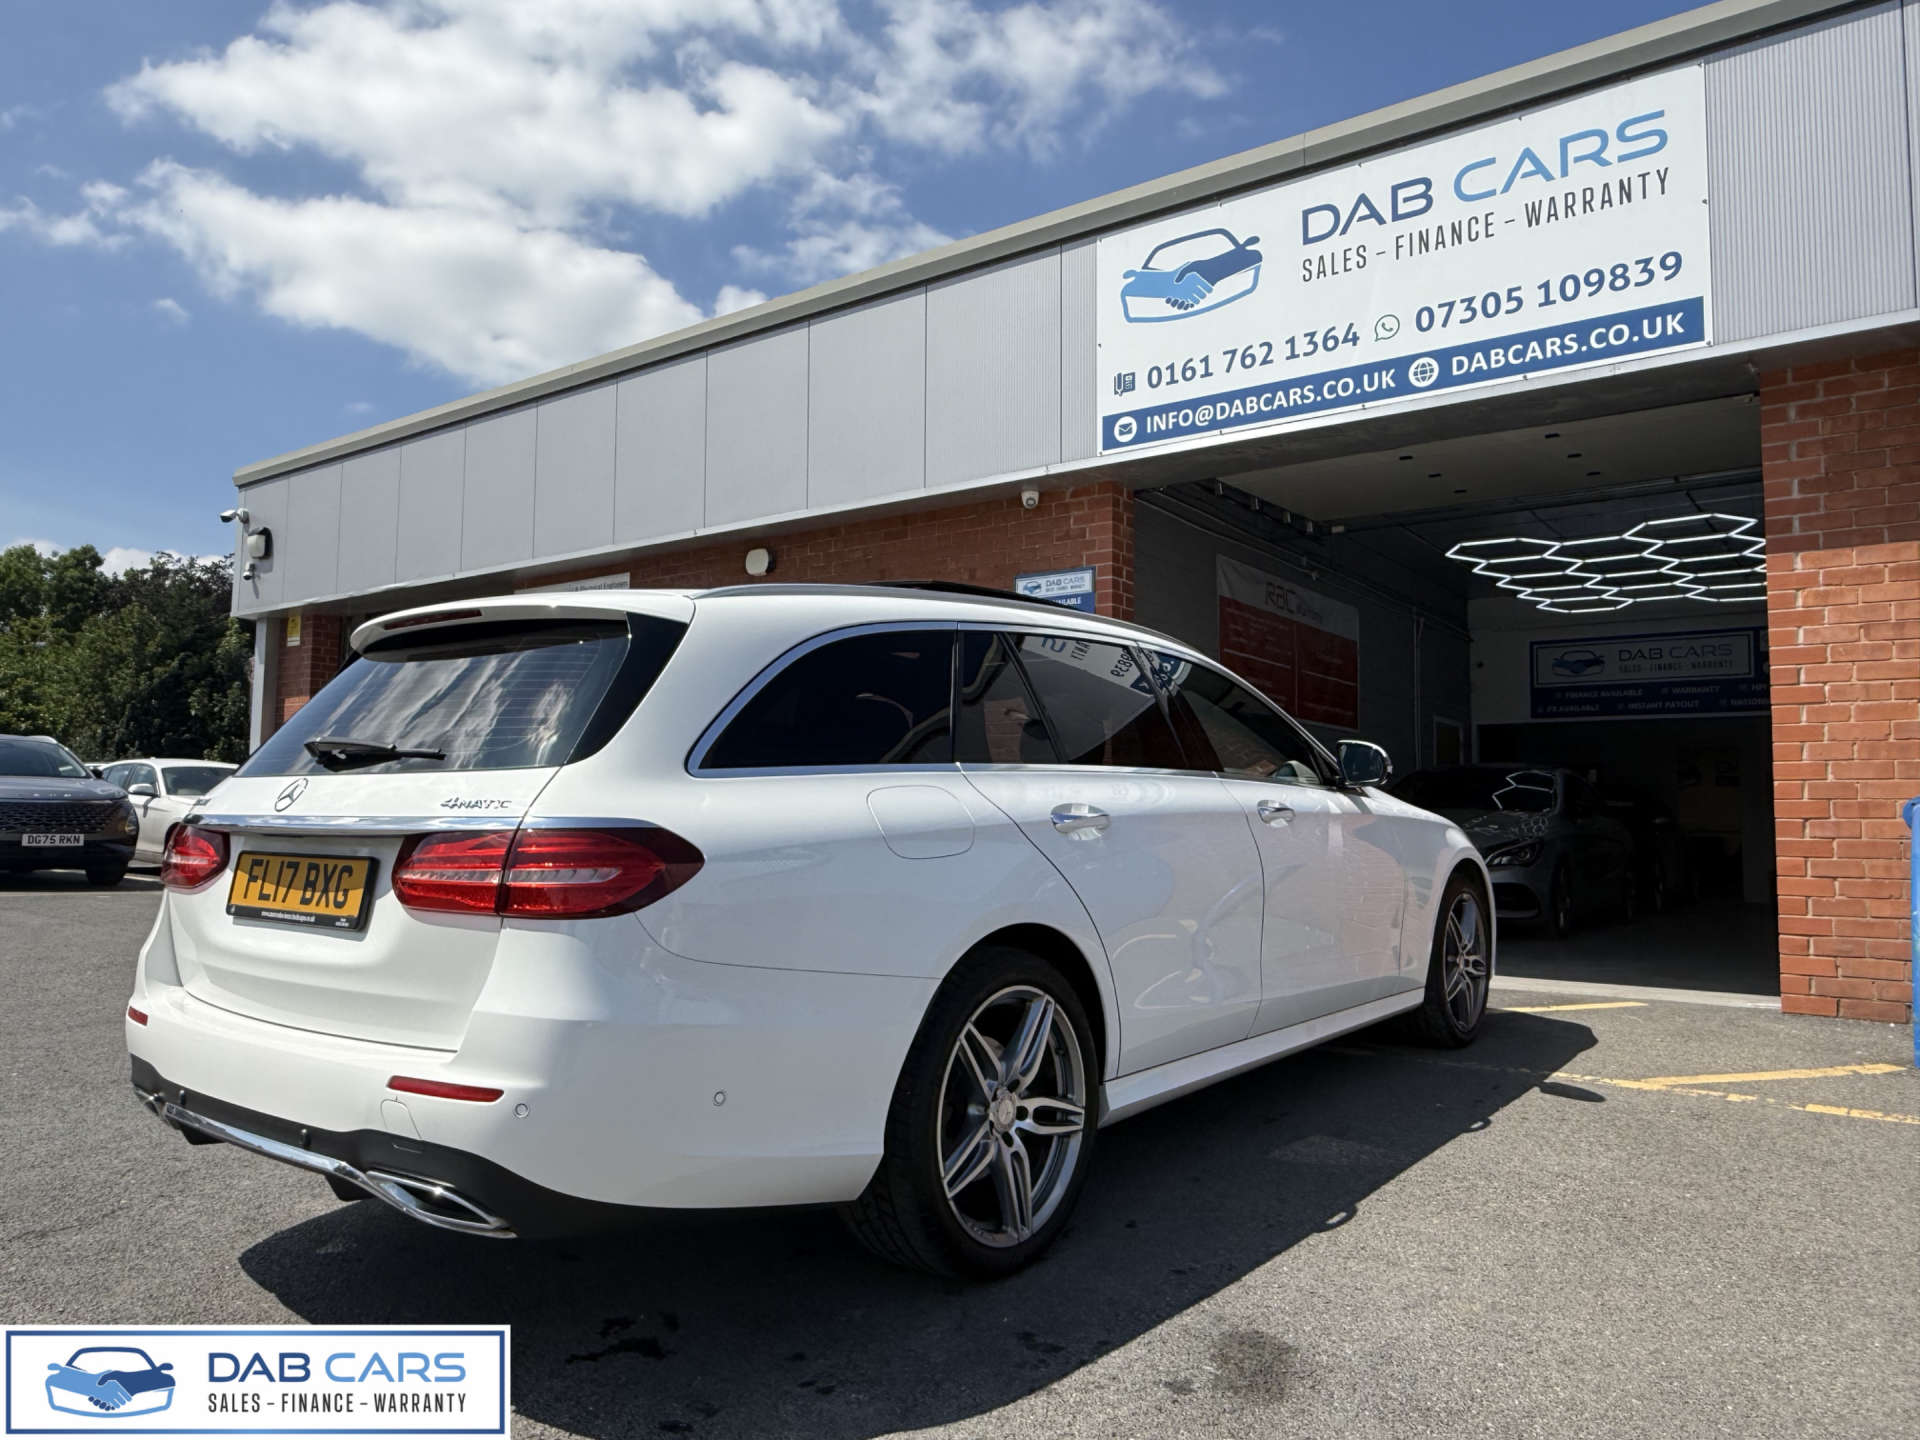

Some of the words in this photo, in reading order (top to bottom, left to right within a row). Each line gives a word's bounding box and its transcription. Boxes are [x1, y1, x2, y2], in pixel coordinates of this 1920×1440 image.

[1302, 176, 1433, 246] DAB
[1454, 109, 1668, 203] CARS
[1302, 244, 1368, 283] SALES
[1395, 212, 1496, 261] FINANCE
[1524, 167, 1671, 229] WARRANTY
[1147, 354, 1214, 389] 0161
[1223, 341, 1274, 373] 762
[1285, 322, 1360, 360] 1364
[1415, 285, 1524, 333] 07305
[1537, 251, 1683, 308] 109839
[1146, 368, 1396, 434] INFO@DABCARS.CO.UK
[1451, 312, 1685, 376] DABCARS.CO.UK
[1619, 647, 1663, 662] DAB
[1669, 643, 1733, 659] CARS
[27, 835, 56, 844] DG75
[59, 835, 80, 844] RKN
[440, 797, 512, 809] 4MATIC
[243, 858, 301, 904] FL17
[300, 862, 353, 909] BXG
